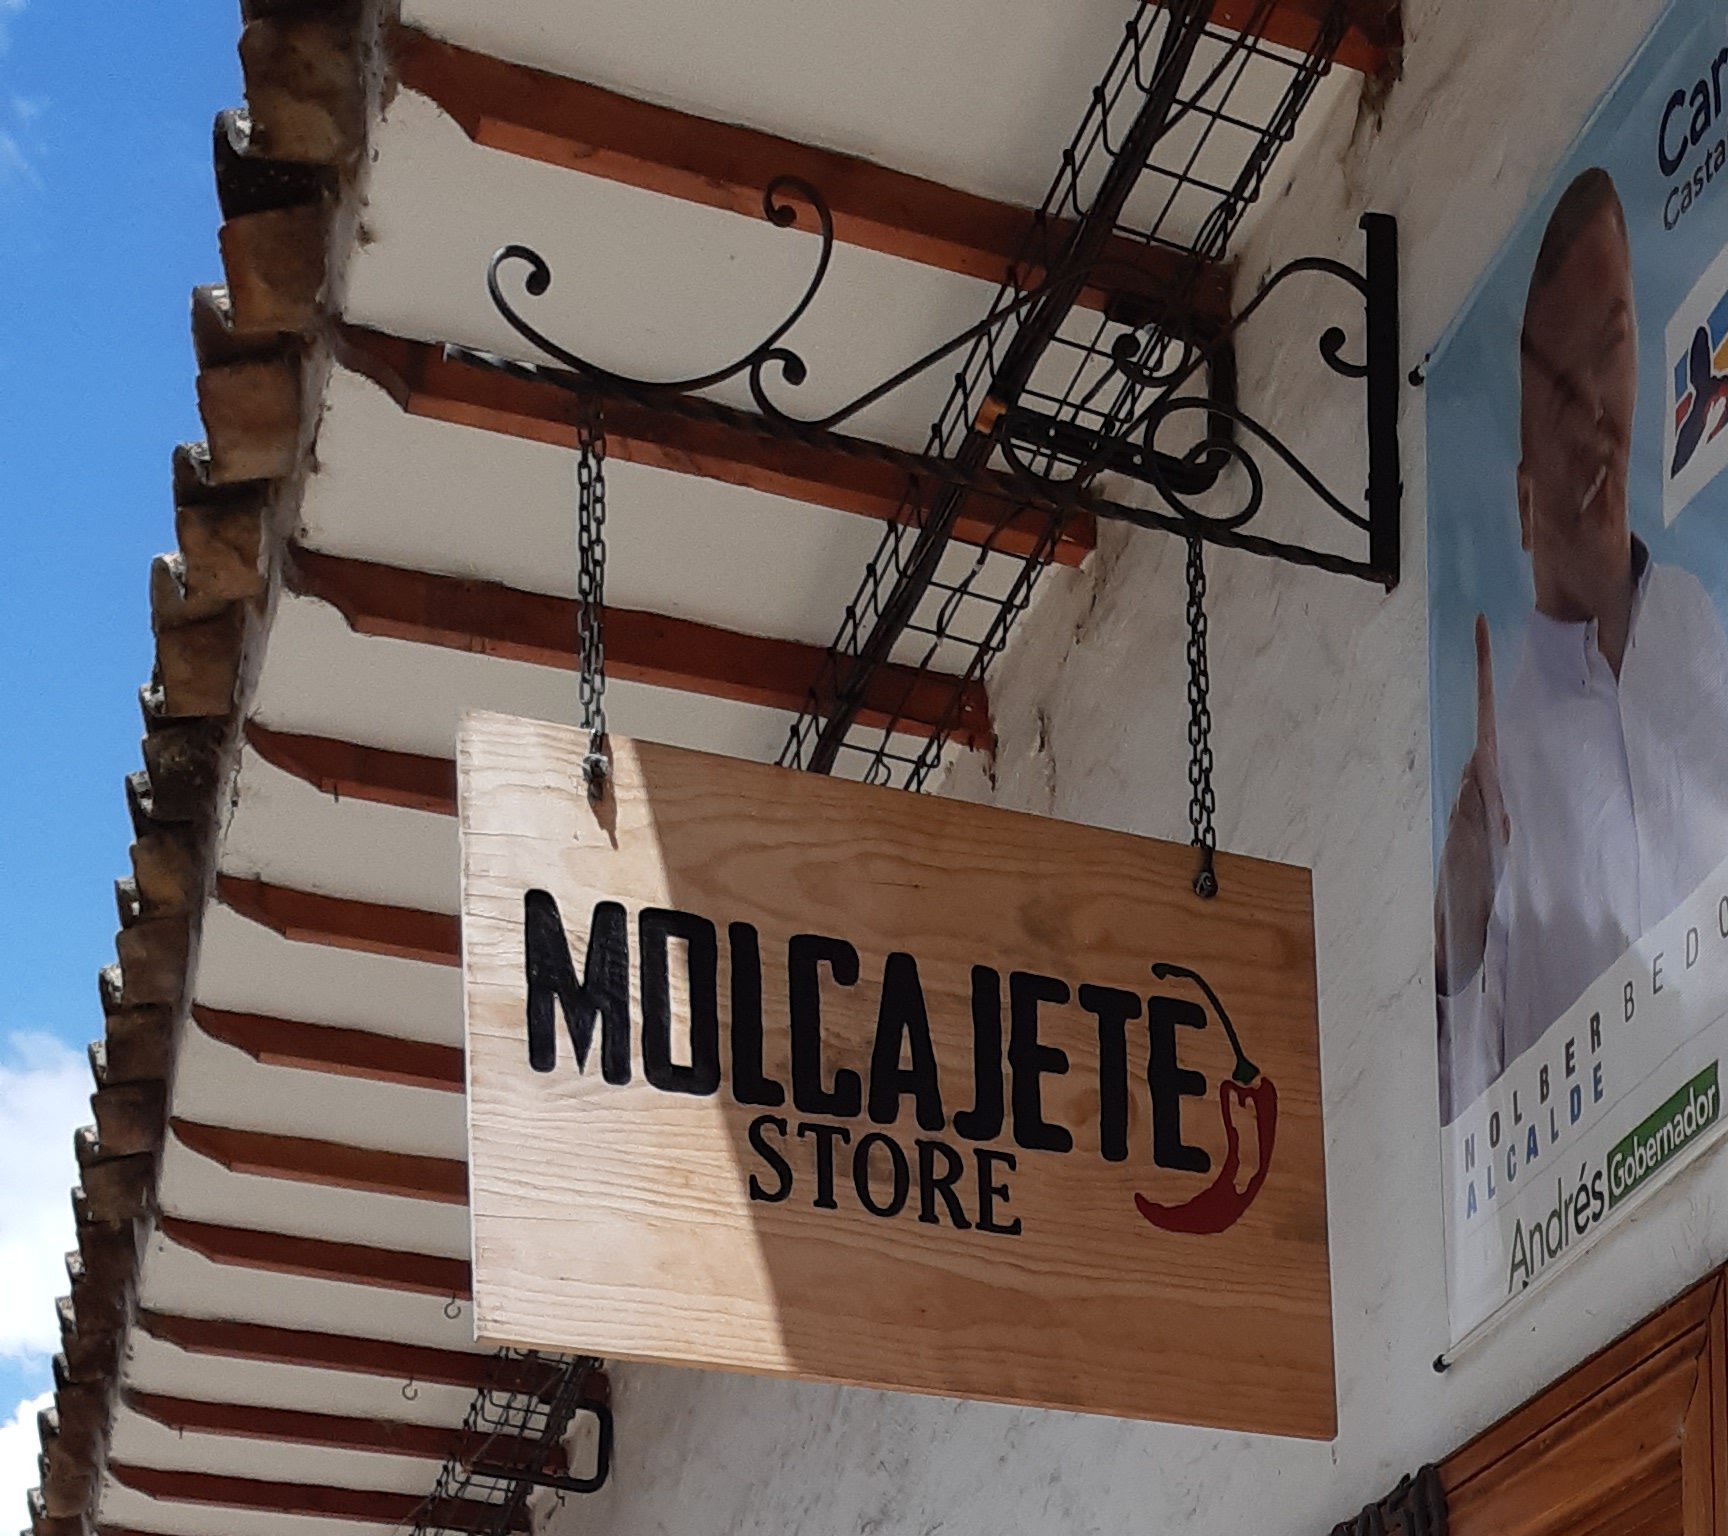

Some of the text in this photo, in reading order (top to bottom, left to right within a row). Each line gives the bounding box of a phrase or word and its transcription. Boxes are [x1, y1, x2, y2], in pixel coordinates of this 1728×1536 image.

[523, 887, 1213, 1174] MOLCAJETE
[747, 1114, 1023, 1236] STORE
[1464, 1061, 1605, 1220] ALCALDE
[1507, 1084, 1718, 1295] Andrés Gobernador
